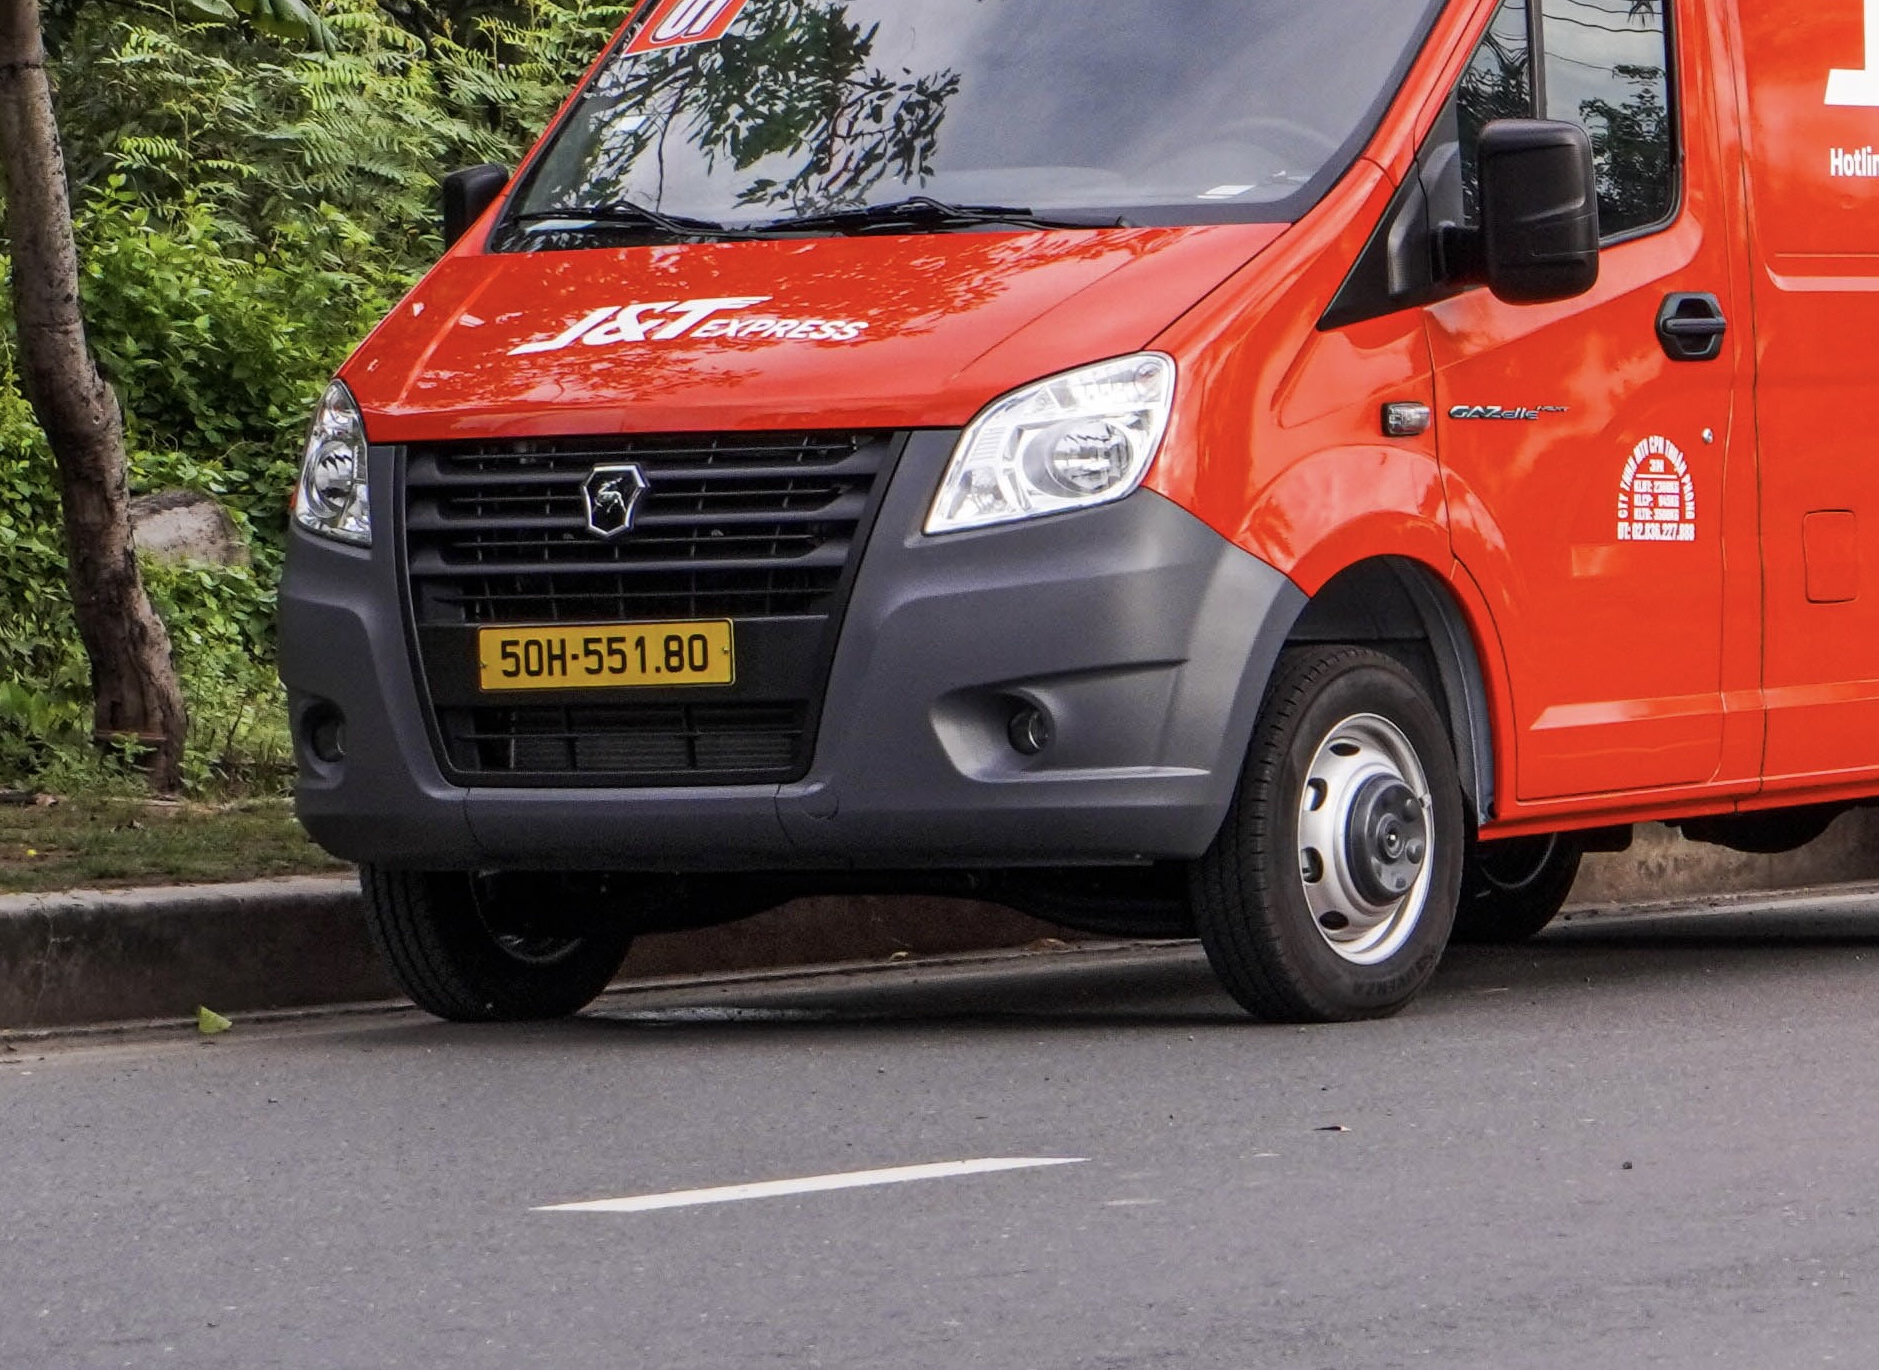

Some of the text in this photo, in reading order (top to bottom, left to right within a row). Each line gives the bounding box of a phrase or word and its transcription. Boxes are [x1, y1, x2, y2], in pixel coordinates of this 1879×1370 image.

[506, 295, 869, 355] J&T EXPRESS
[501, 633, 709, 677] 50H-551.80
